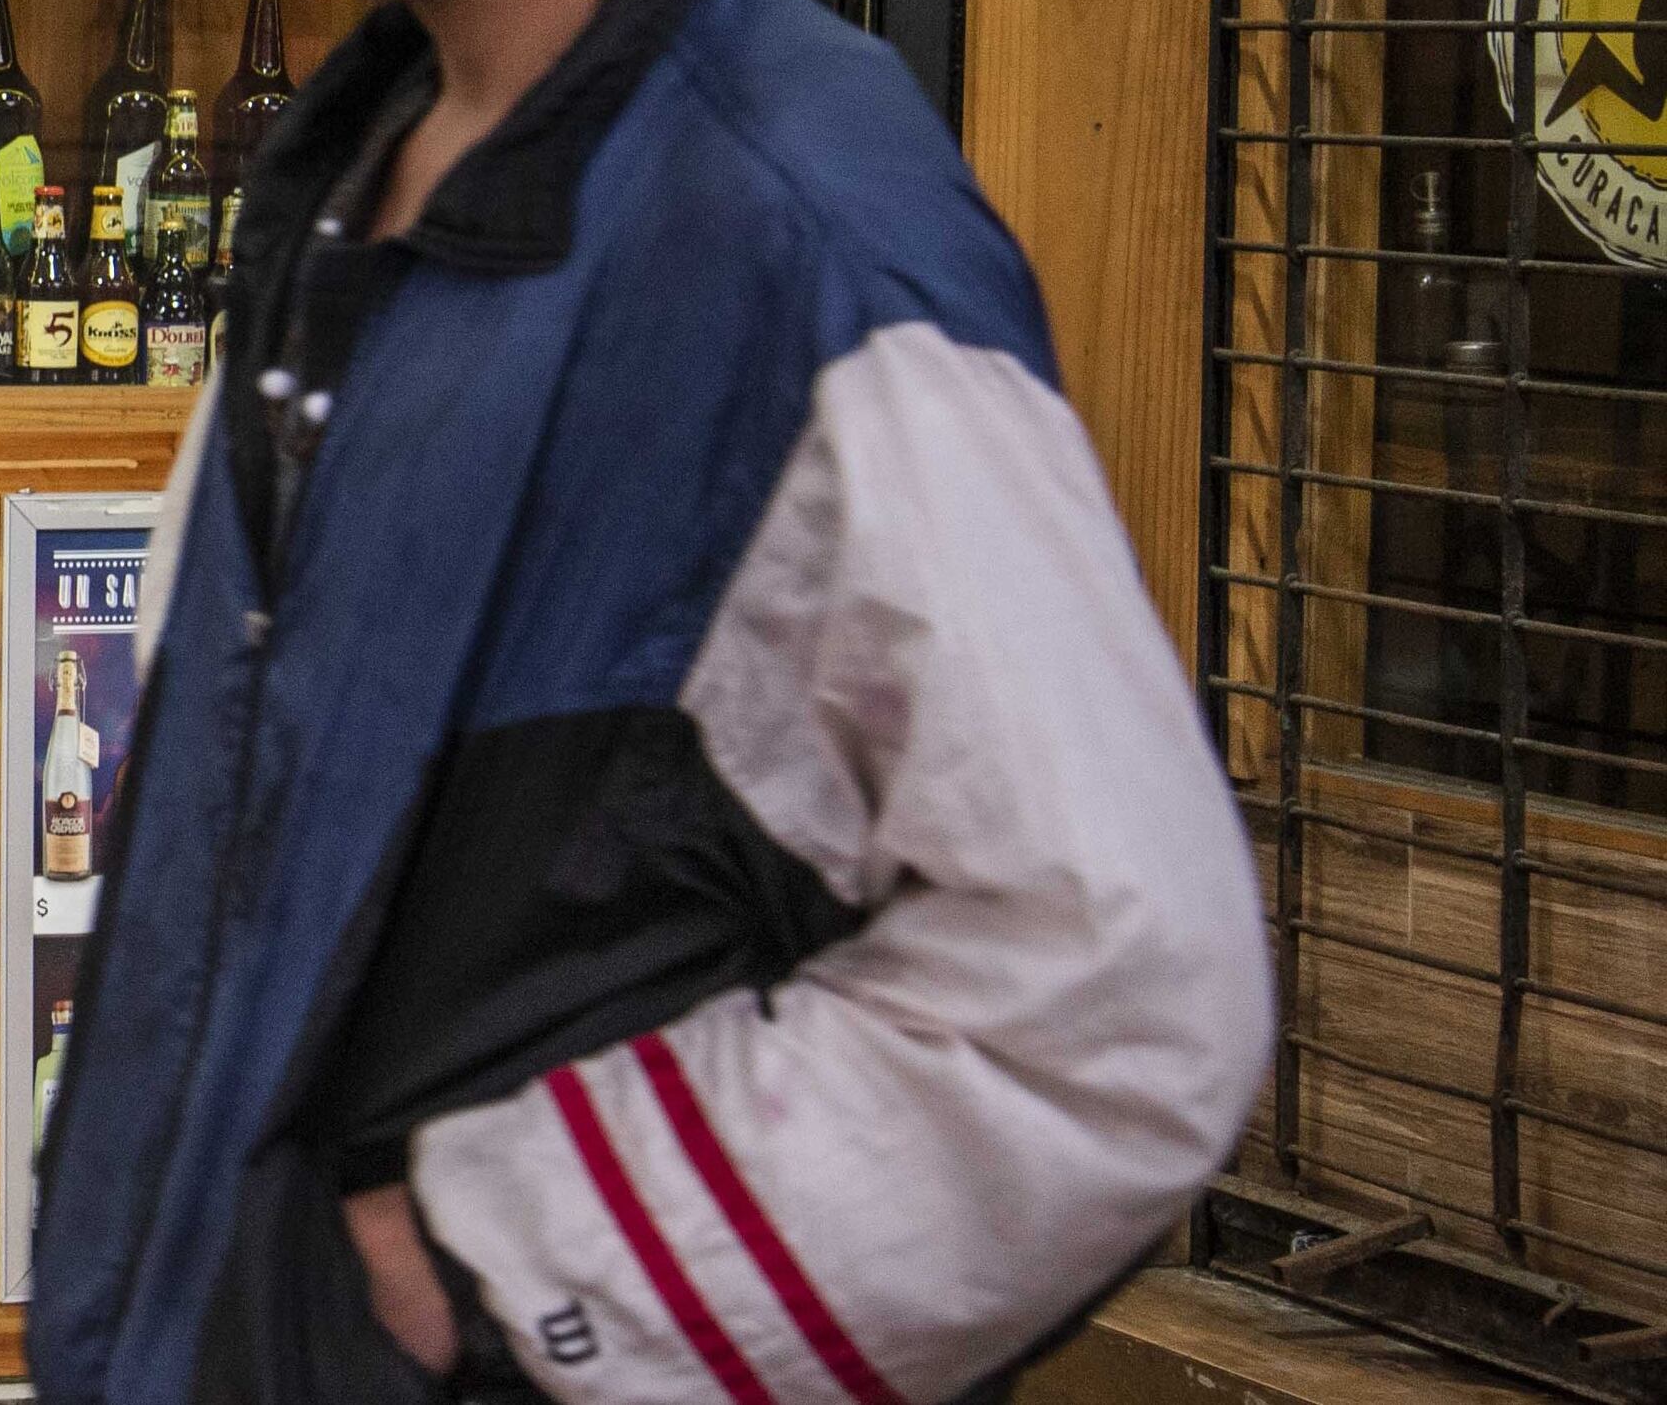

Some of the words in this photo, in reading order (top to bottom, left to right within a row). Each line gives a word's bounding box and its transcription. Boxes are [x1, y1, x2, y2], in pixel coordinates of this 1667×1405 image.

[44, 310, 75, 347] 5
[58, 573, 91, 609] UN
[36, 897, 49, 918] $
